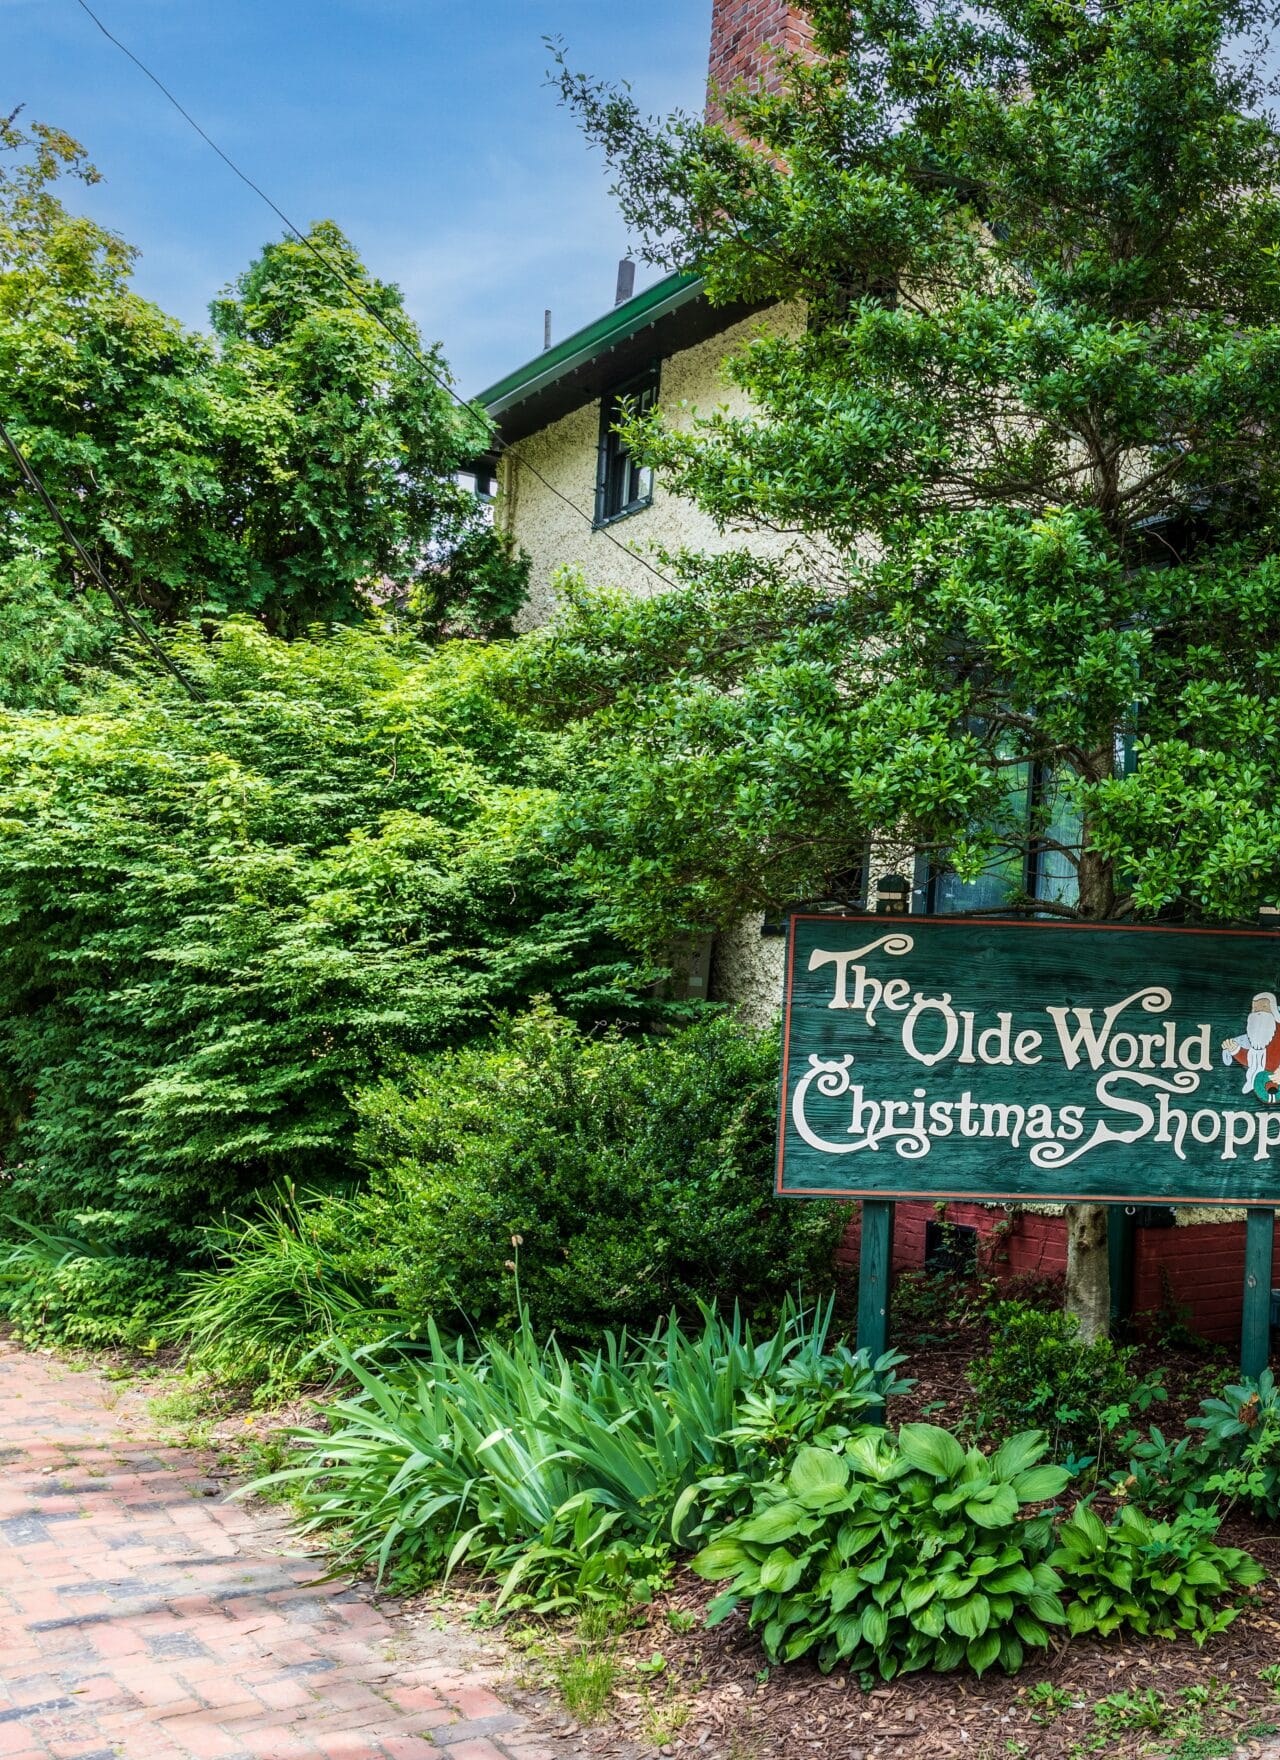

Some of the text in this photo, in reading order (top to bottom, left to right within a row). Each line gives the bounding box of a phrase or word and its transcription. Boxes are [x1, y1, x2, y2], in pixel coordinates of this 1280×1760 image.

[807, 933, 1213, 1073] The Olde World
[791, 1053, 1086, 1159] Christmas
